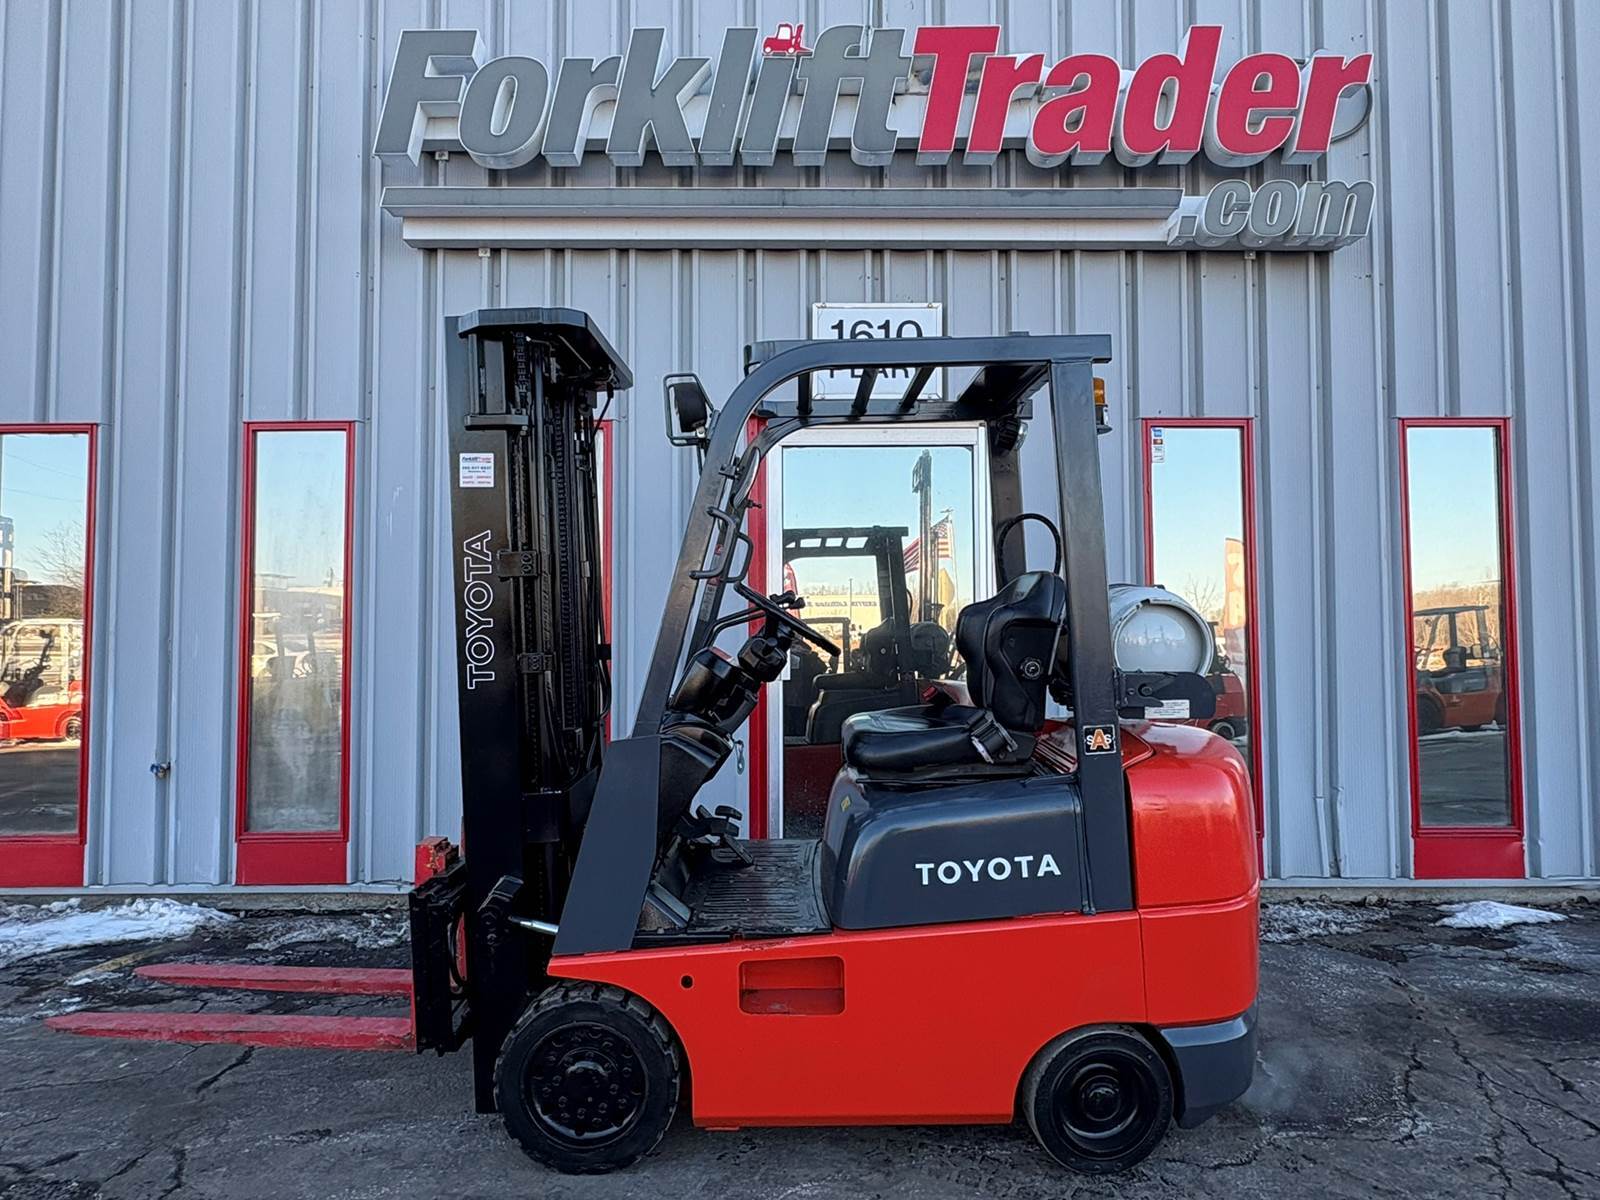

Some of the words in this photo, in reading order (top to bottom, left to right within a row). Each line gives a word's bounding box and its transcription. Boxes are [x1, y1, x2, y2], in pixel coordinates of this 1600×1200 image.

[373, 25, 1374, 160] ForkliftTrader
[1177, 178, 1375, 238] .com
[463, 529, 495, 690] TOYOTA
[914, 853, 1062, 886] TOYOTA
